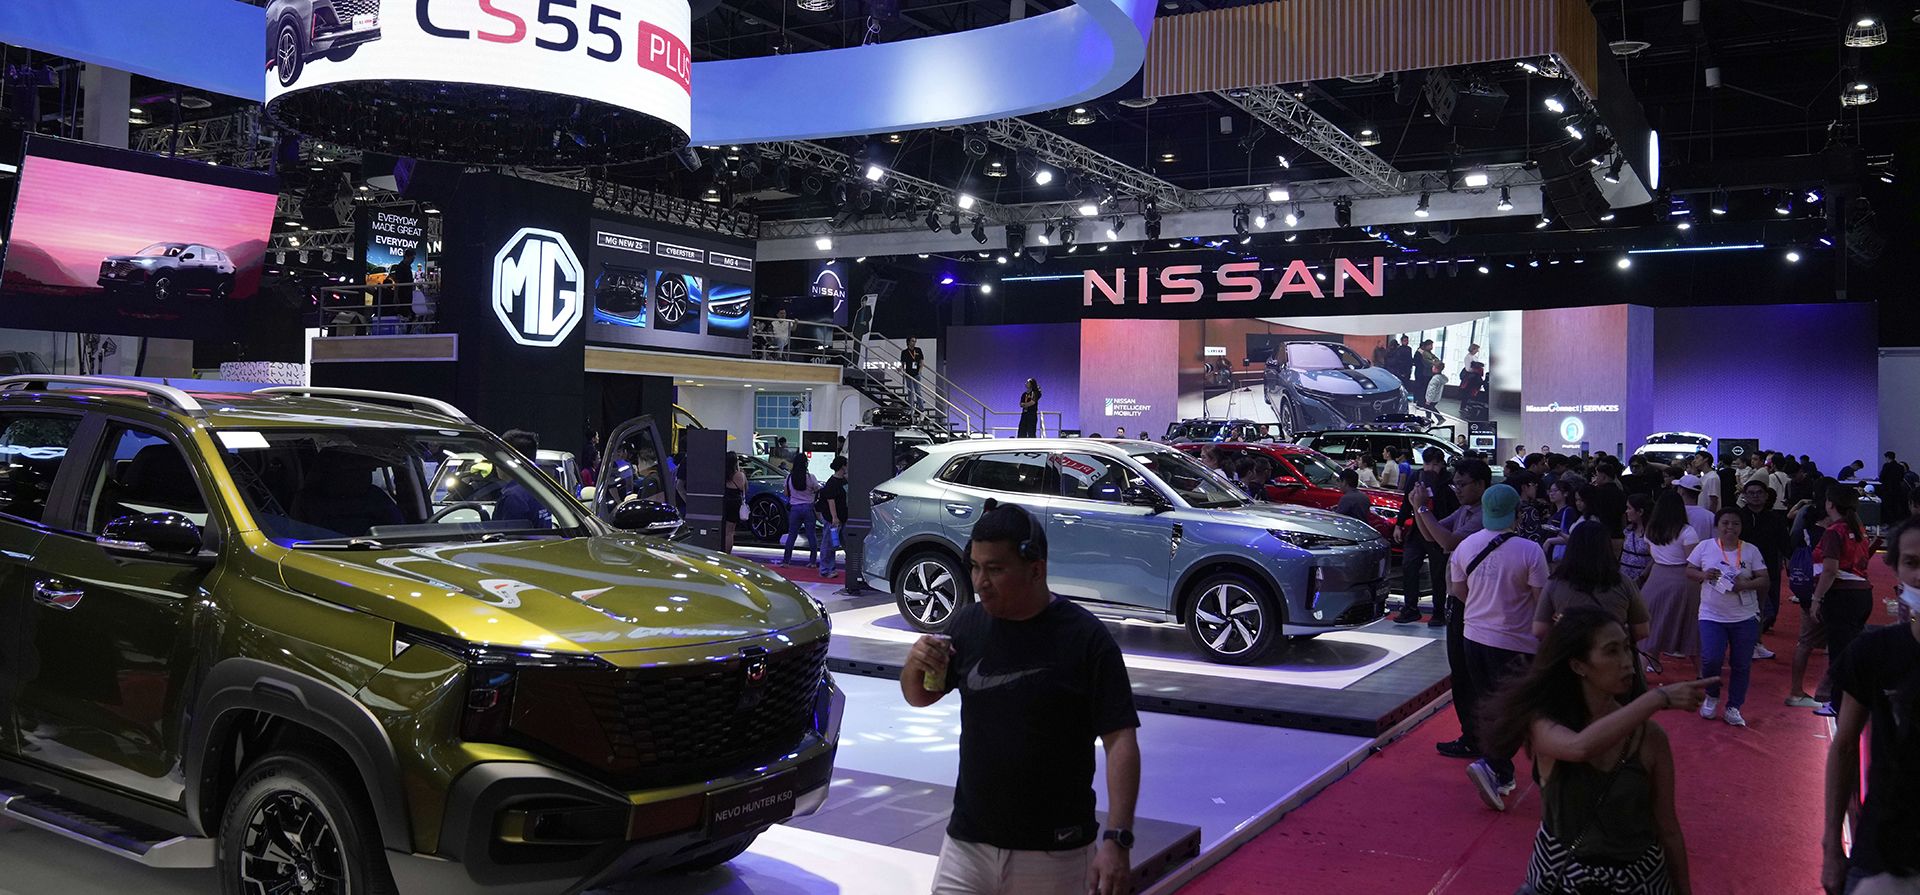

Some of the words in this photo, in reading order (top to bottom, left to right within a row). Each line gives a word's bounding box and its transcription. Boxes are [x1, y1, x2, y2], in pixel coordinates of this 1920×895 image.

[650, 33, 690, 85] PLUS
[377, 212, 418, 226] EVERYDAY
[372, 221, 395, 232] MADE
[397, 225, 422, 236] GREAT
[375, 235, 418, 249] EVERYDAY
[605, 236, 617, 246] MG
[618, 238, 634, 248] NEW
[389, 247, 403, 256] MG
[666, 247, 695, 258] CYBERSTER
[724, 257, 734, 265] MG
[502, 239, 577, 336] MG
[1083, 256, 1384, 306] NISSAN
[812, 286, 845, 298] NISSAN
[715, 806, 740, 822] NEVO
[742, 796, 775, 814] HUNTER
[777, 790, 793, 803] K50
